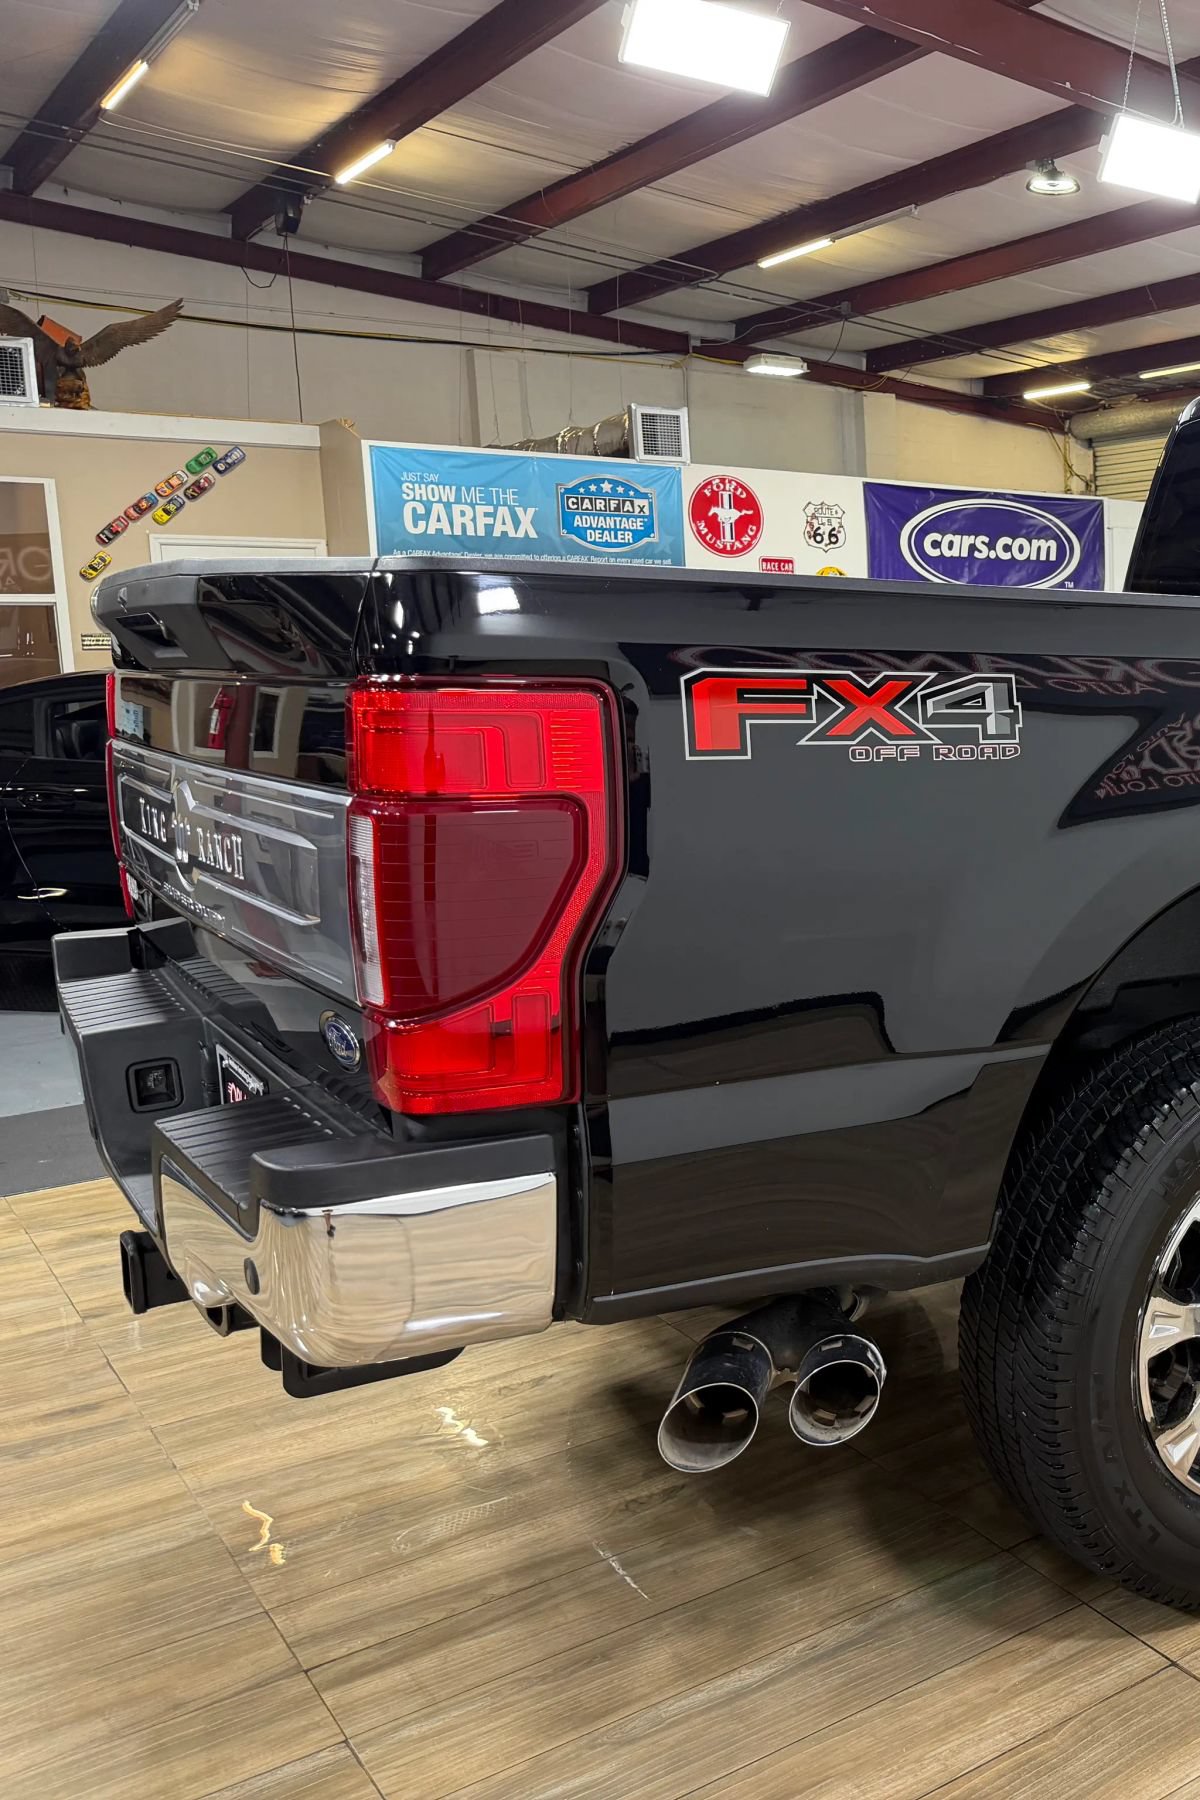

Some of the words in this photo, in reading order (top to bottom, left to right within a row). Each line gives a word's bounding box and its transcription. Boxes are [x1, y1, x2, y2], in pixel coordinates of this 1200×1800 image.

[401, 472, 422, 482] JUST
[423, 473, 439, 482] SAY
[402, 482, 456, 503] SHOW
[461, 487, 485, 503] ME
[489, 488, 519, 506] THE
[703, 483, 747, 499] FORD
[567, 497, 646, 515] CARFAX
[814, 507, 835, 516] ROUTE
[403, 502, 538, 539] CARFAX
[573, 514, 645, 531] ADVANTAGE
[586, 529, 633, 544] DEALER
[696, 520, 757, 551] MUSTANG
[924, 530, 1057, 563] cars.com
[761, 561, 779, 571] RACE
[780, 562, 793, 571] CAR
[680, 668, 1023, 760] FX4
[849, 745, 920, 762] OFF
[933, 744, 1021, 761] ROAD
[139, 797, 167, 842] KING
[197, 827, 244, 880] RANCH
[327, 1026, 347, 1057] Ford
